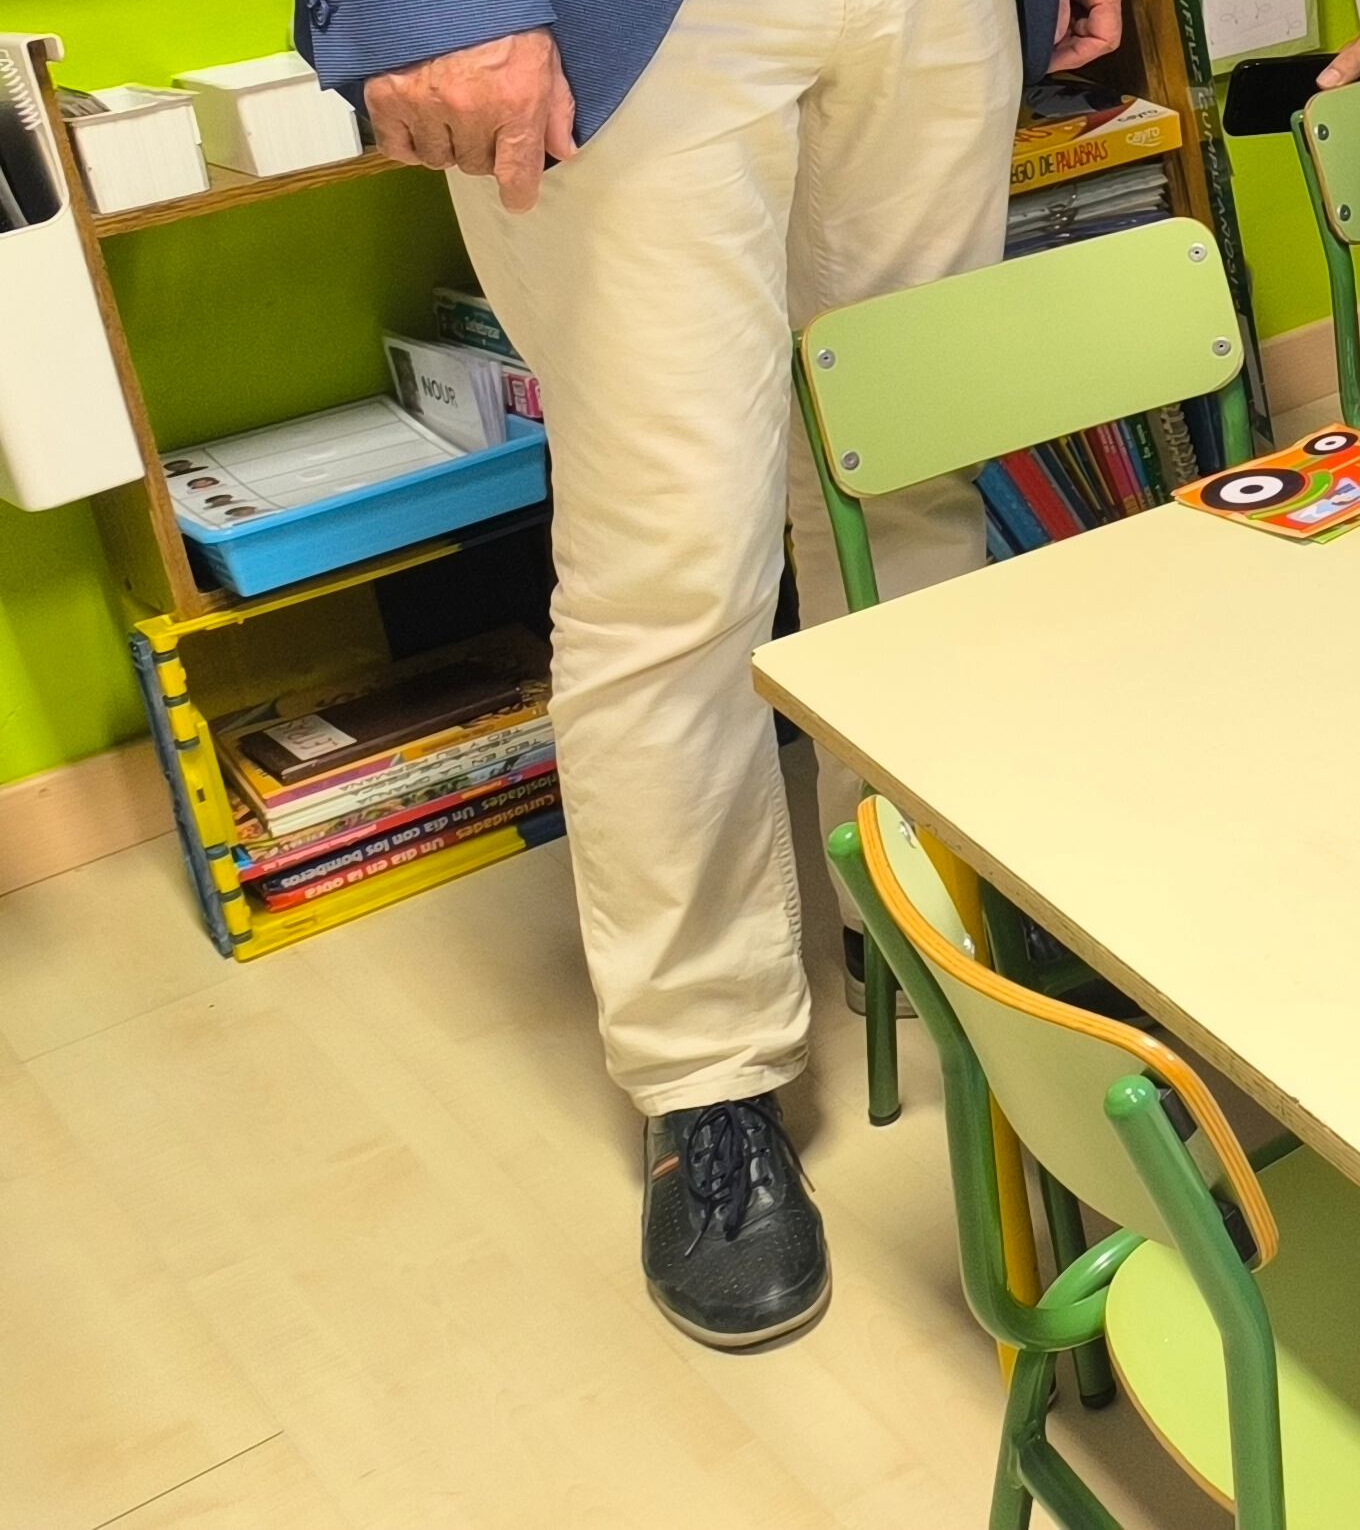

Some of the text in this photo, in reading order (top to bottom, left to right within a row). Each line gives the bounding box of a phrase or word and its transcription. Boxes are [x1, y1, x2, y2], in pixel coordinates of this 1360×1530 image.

[1124, 126, 1162, 145] cayro
[1038, 152, 1055, 177] DE
[1055, 139, 1109, 174] PALABRAS
[472, 751, 498, 767] EN
[504, 737, 542, 755] TEO
[280, 806, 476, 889] Un día con los bomberos
[303, 794, 556, 900] Curiosidades Un día en la obra
